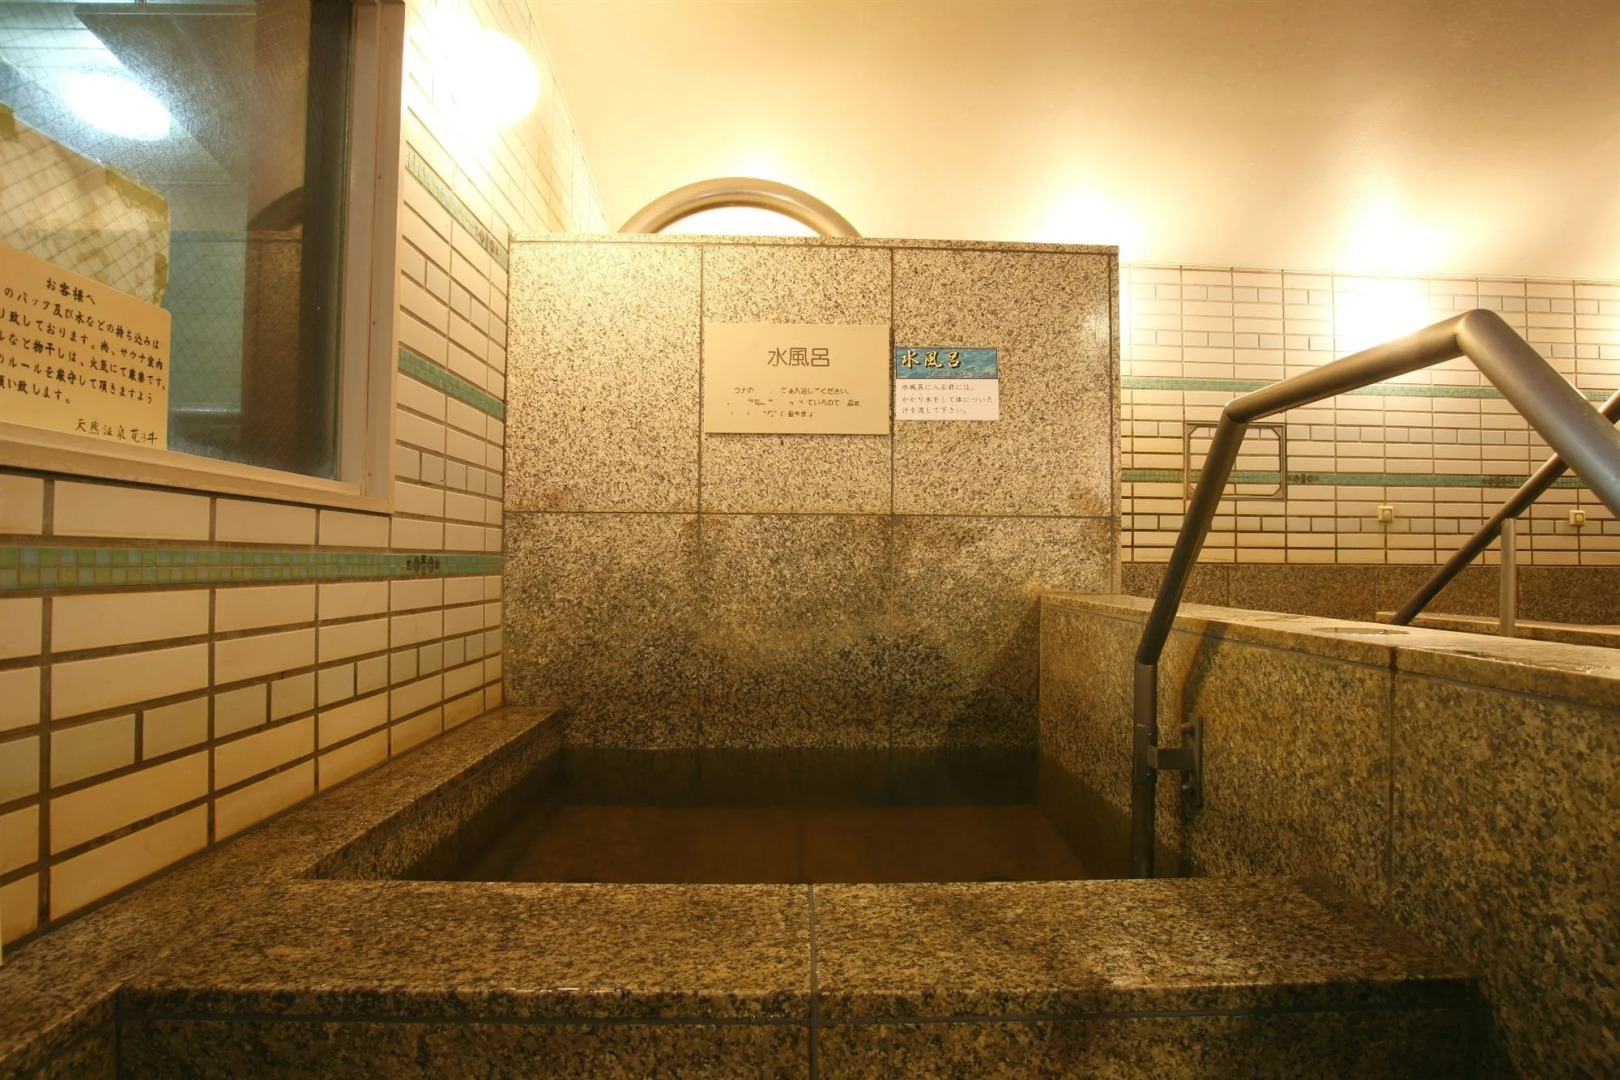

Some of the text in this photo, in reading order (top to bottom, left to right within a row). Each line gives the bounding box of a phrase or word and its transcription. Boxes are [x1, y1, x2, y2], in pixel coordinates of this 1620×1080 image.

[46, 277, 97, 306] お客様へ
[0, 287, 159, 350] のパック及び水などの持ち込みは
[767, 347, 830, 368] 水風呂
[900, 349, 962, 369] 水風呂
